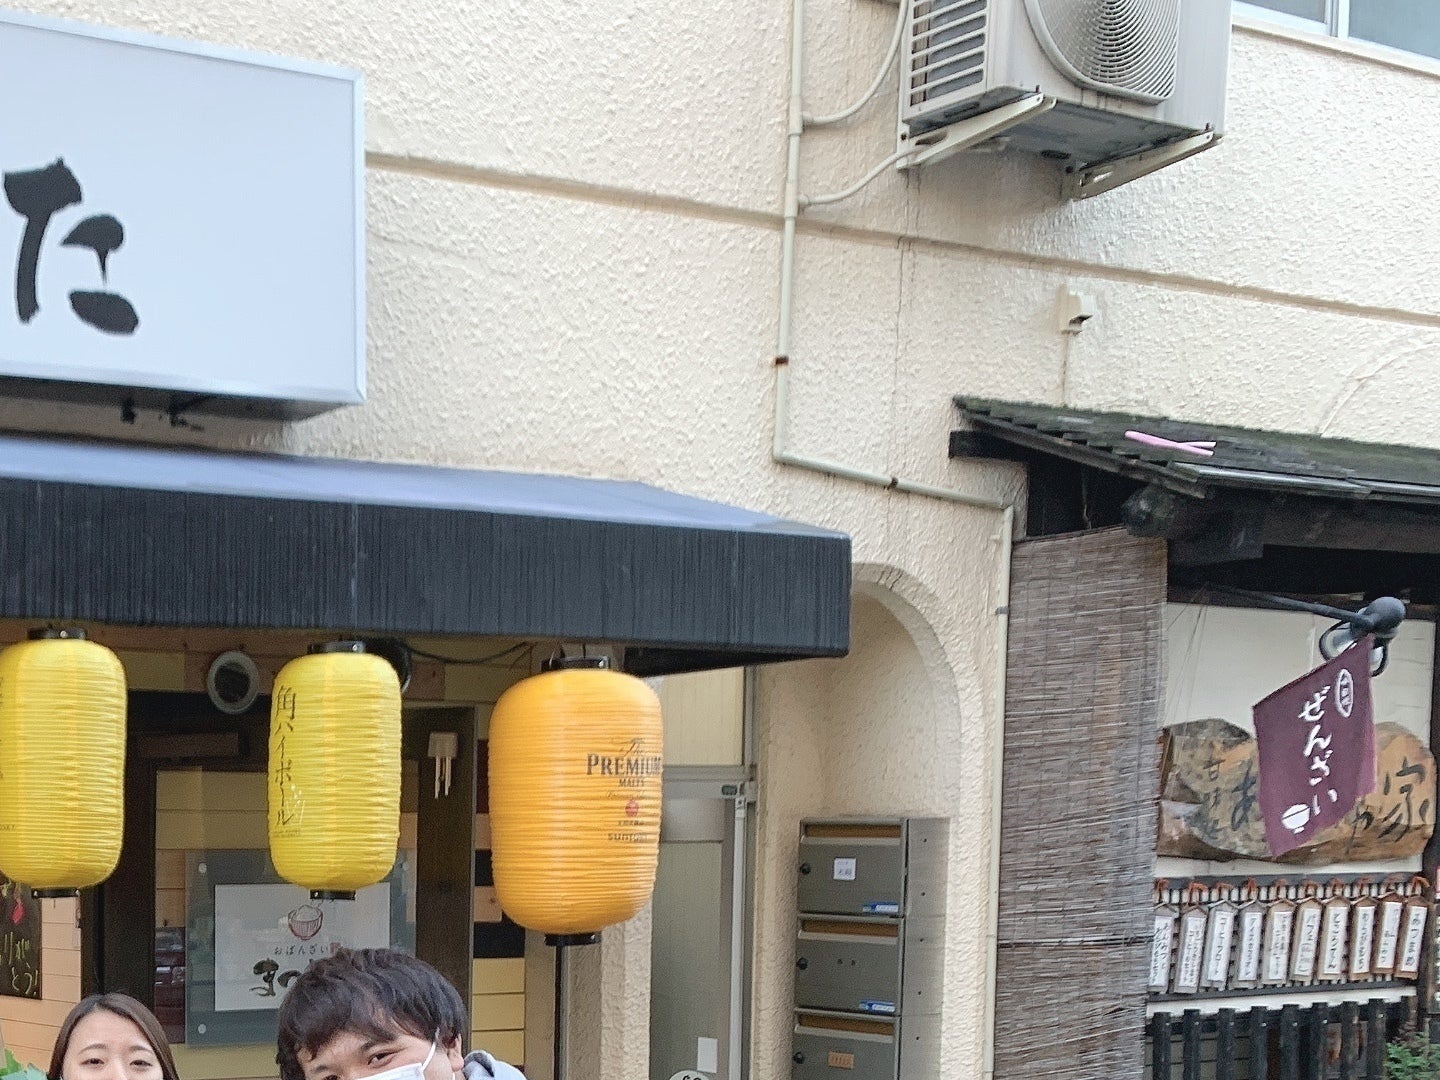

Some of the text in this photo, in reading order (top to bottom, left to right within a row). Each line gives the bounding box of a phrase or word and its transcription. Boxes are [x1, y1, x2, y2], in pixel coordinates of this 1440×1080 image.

[274, 684, 297, 826] 角ハイボール
[1298, 685, 1338, 816] ぜんざい
[274, 945, 329, 955] おばんざい
